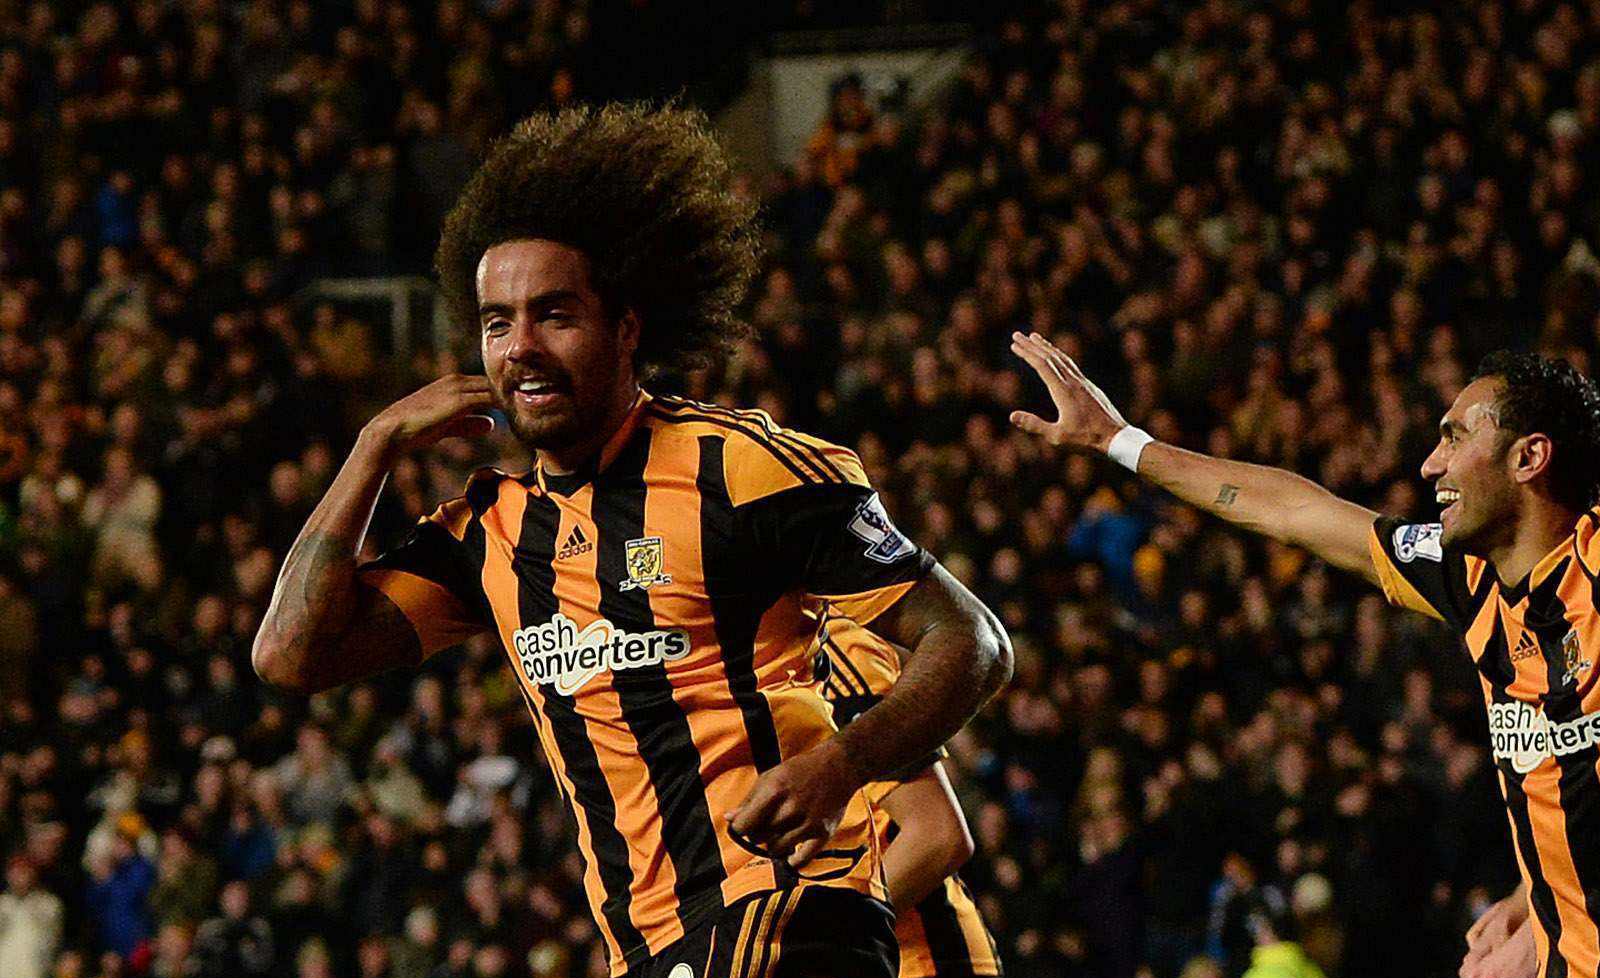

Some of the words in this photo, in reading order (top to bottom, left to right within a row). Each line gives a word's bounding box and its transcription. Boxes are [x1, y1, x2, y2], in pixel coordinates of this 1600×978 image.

[515, 619, 574, 657] cash
[522, 632, 685, 682] converters
[1490, 701, 1532, 730] ash
